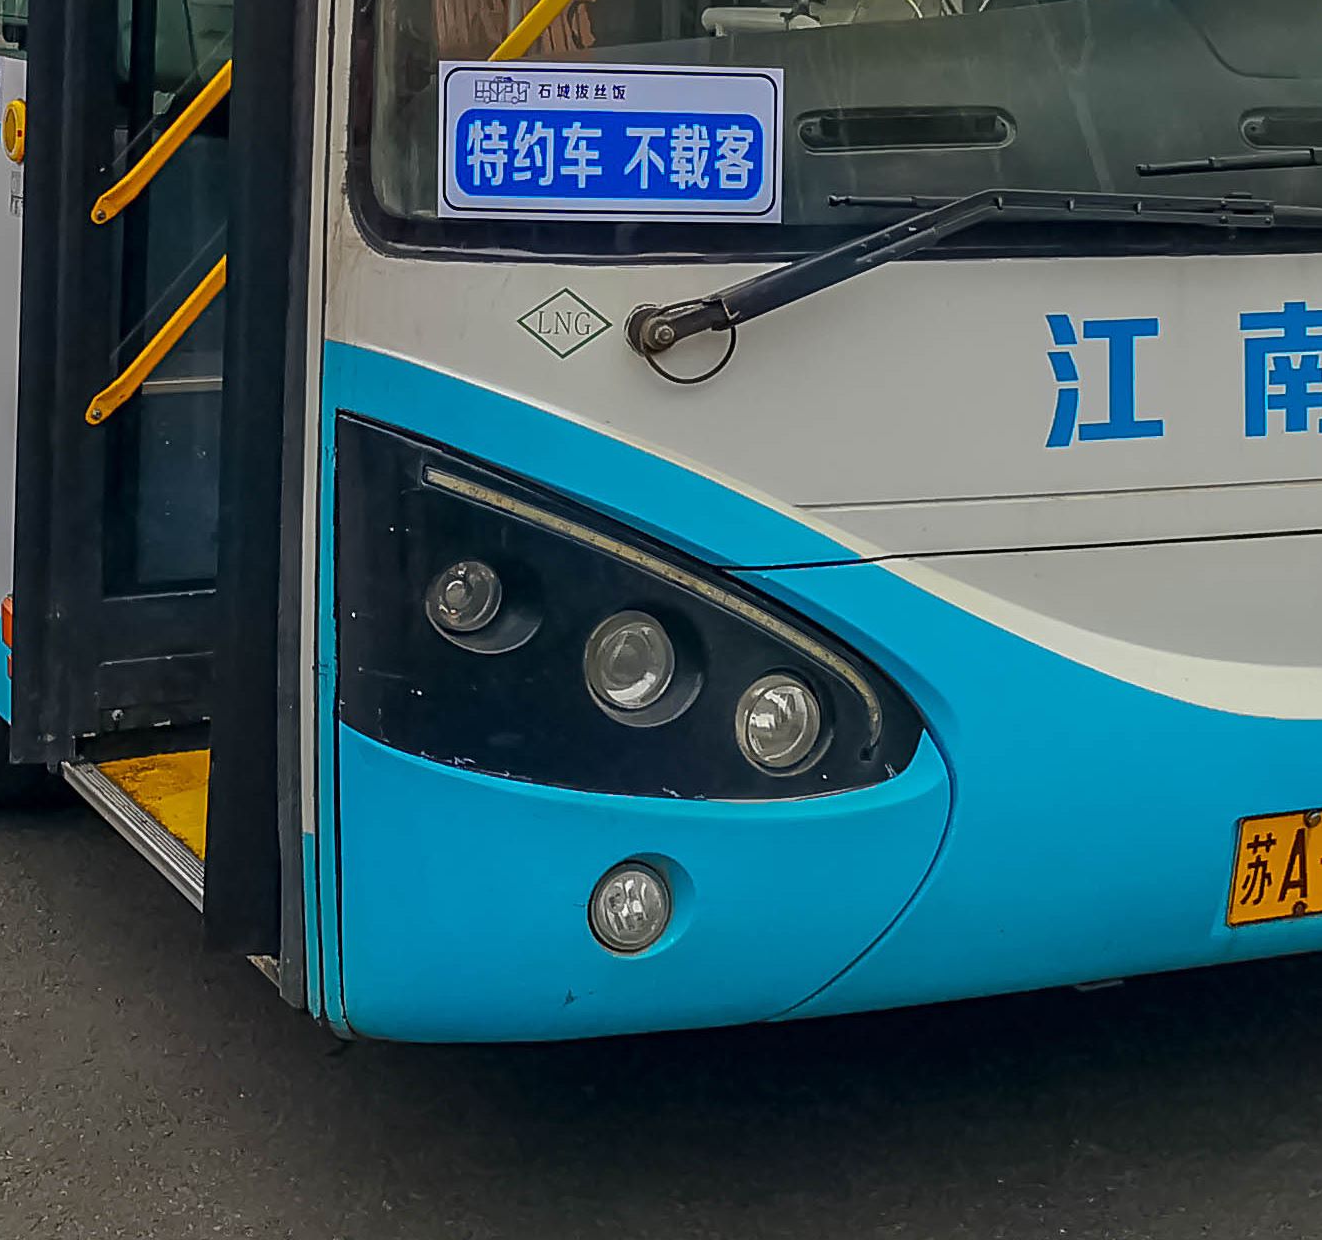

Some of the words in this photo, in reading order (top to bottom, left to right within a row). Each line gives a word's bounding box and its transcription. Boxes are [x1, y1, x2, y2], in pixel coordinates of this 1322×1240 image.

[466, 119, 603, 189] 特约车
[623, 124, 755, 190] 不载客
[537, 311, 592, 336] LNG
